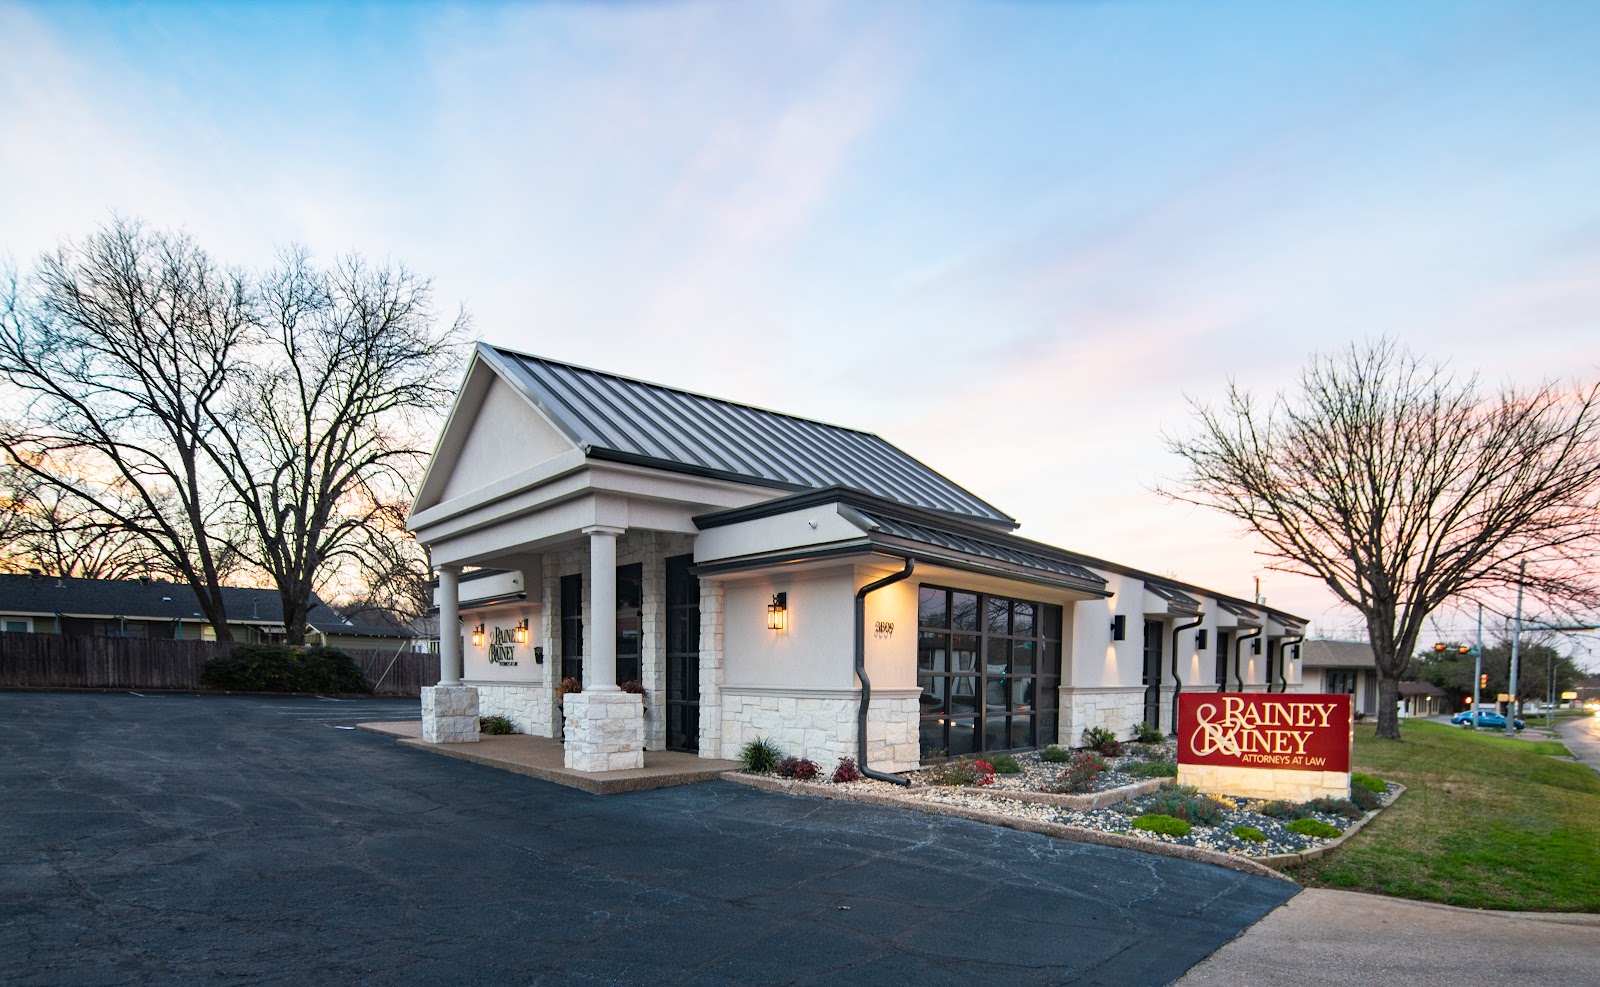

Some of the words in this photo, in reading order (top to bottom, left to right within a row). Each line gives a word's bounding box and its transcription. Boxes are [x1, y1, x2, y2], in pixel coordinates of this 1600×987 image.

[494, 627, 516, 645] RAINE
[1221, 696, 1337, 729] RAINEY
[1190, 703, 1242, 758] &
[1200, 723, 1313, 755] RAINEY
[1241, 754, 1290, 765] ATTORNEYS
[1291, 756, 1303, 765] AT
[1305, 757, 1326, 766] LAW
